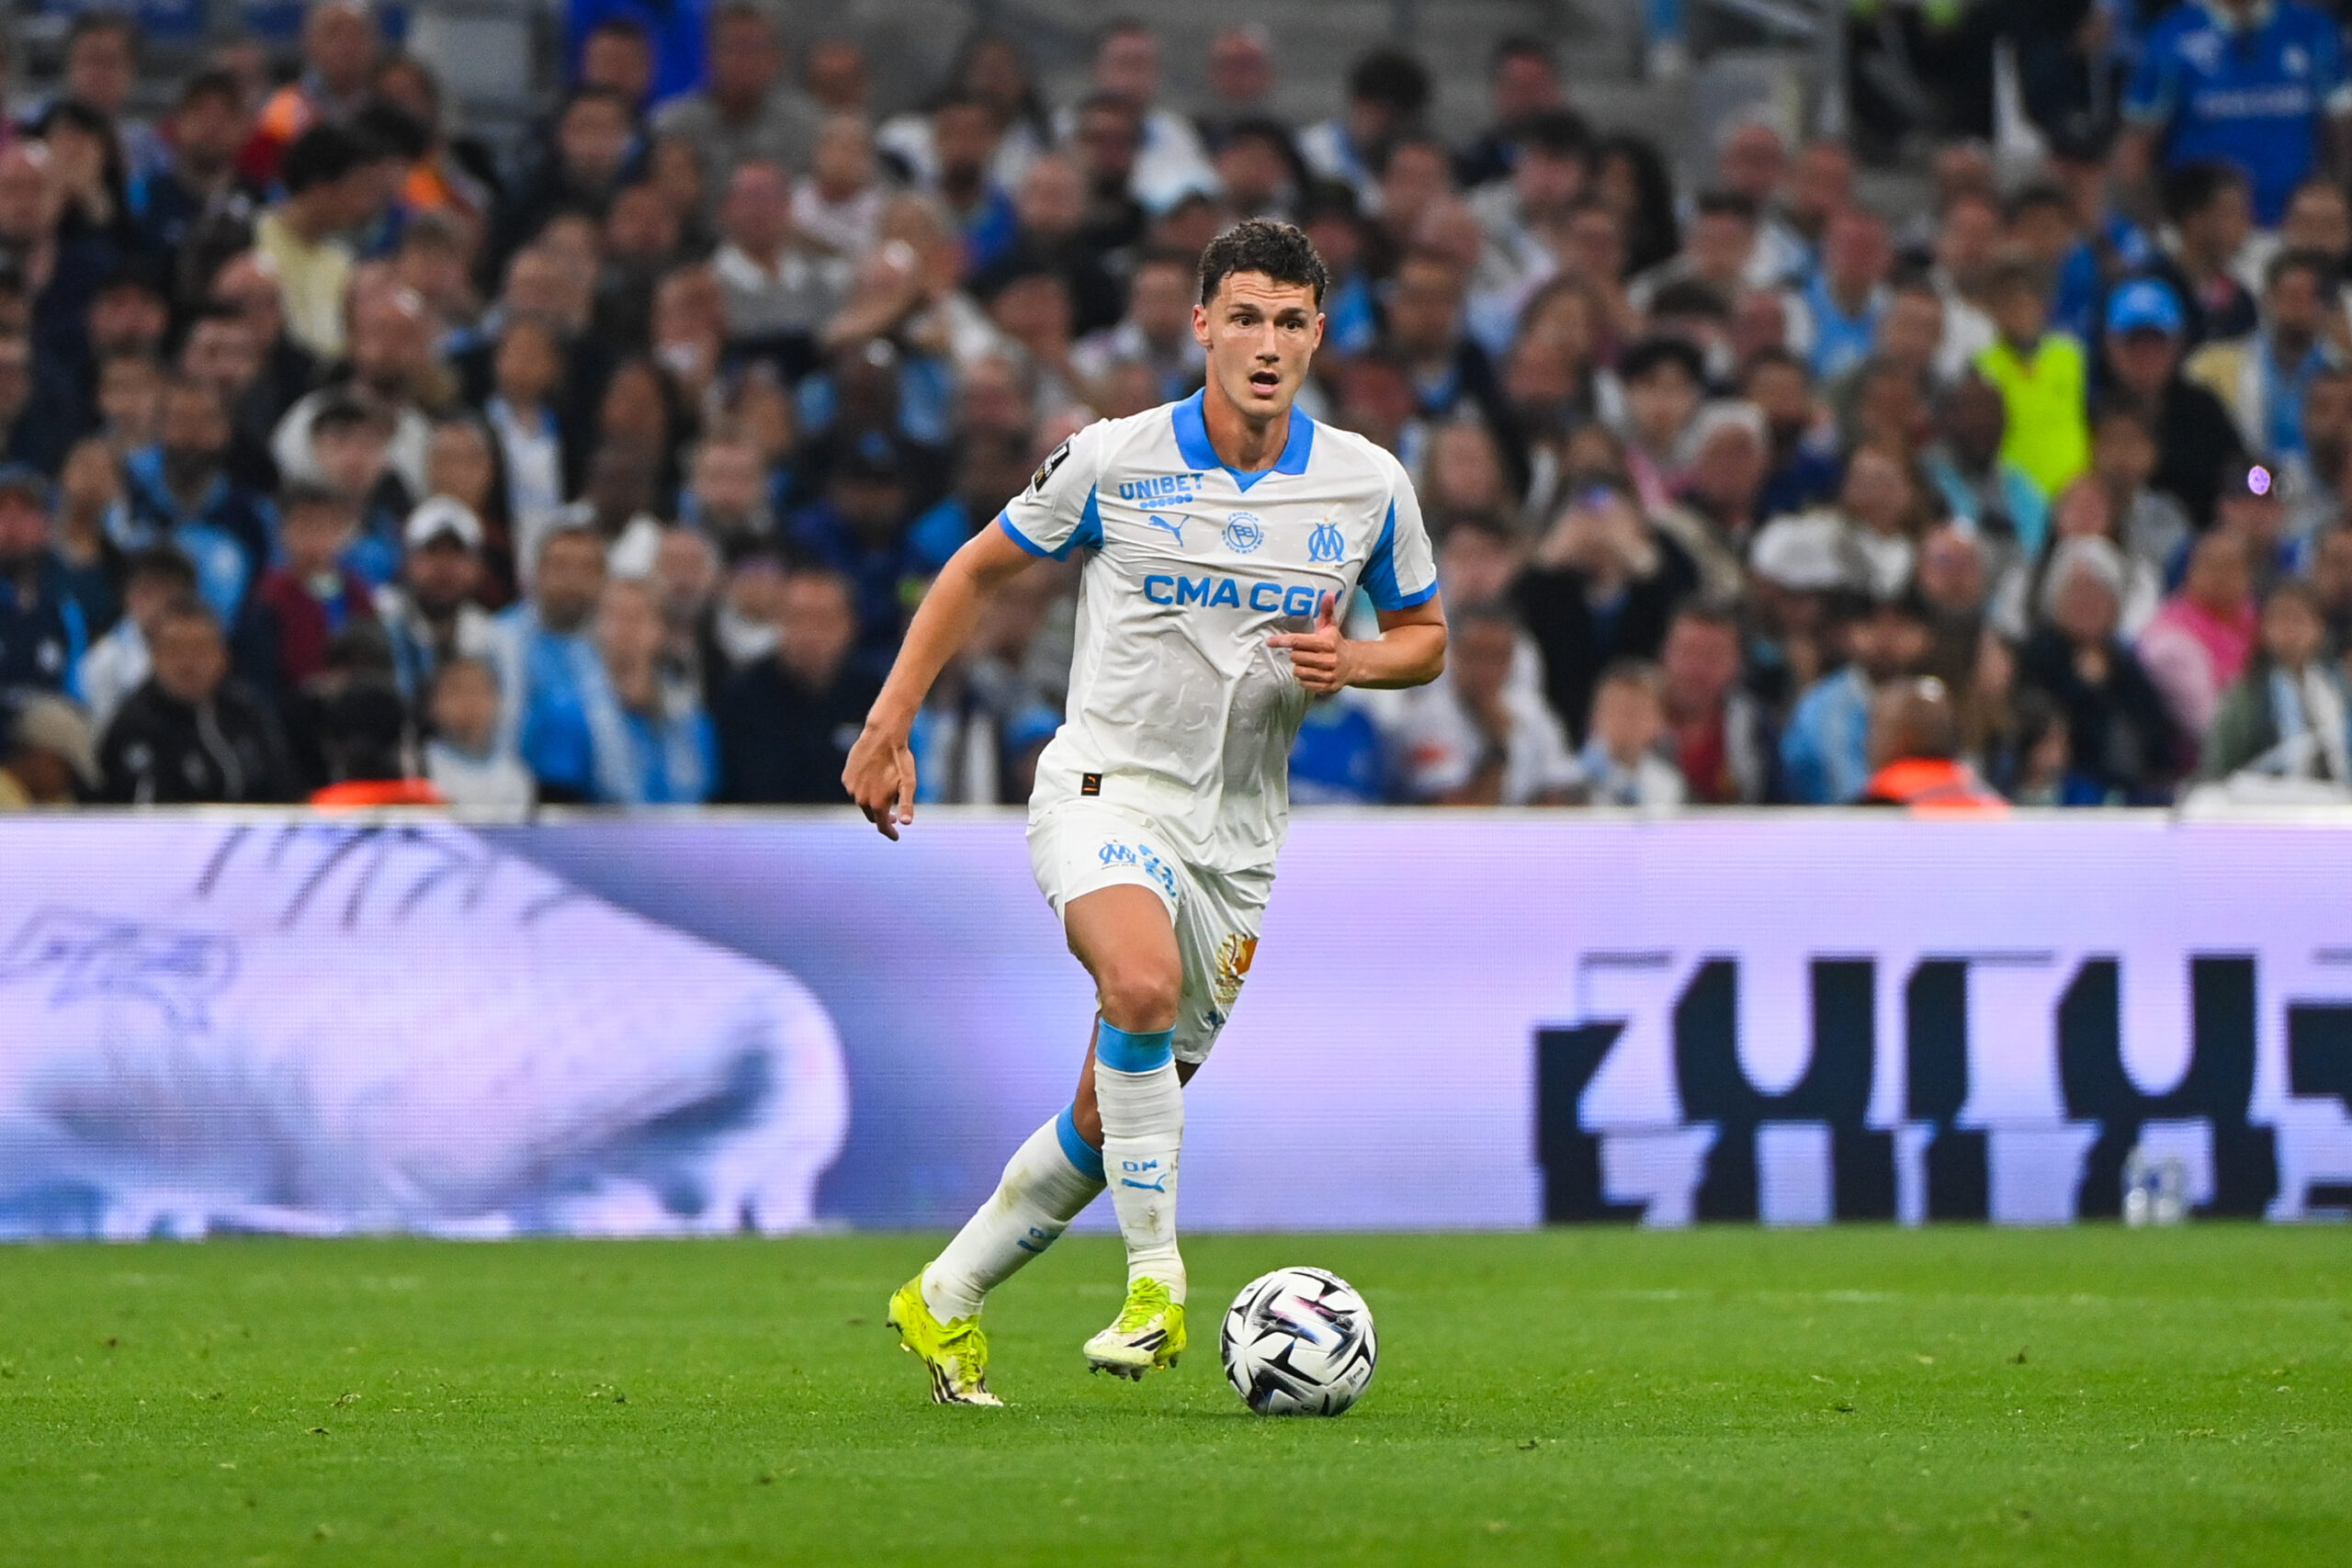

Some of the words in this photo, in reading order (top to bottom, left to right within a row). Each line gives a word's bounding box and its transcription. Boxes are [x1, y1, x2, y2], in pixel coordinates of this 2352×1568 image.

[1119, 473, 1204, 501] UNIBET
[1144, 574, 1240, 608] CMA
[1122, 1158, 1158, 1172] OM
